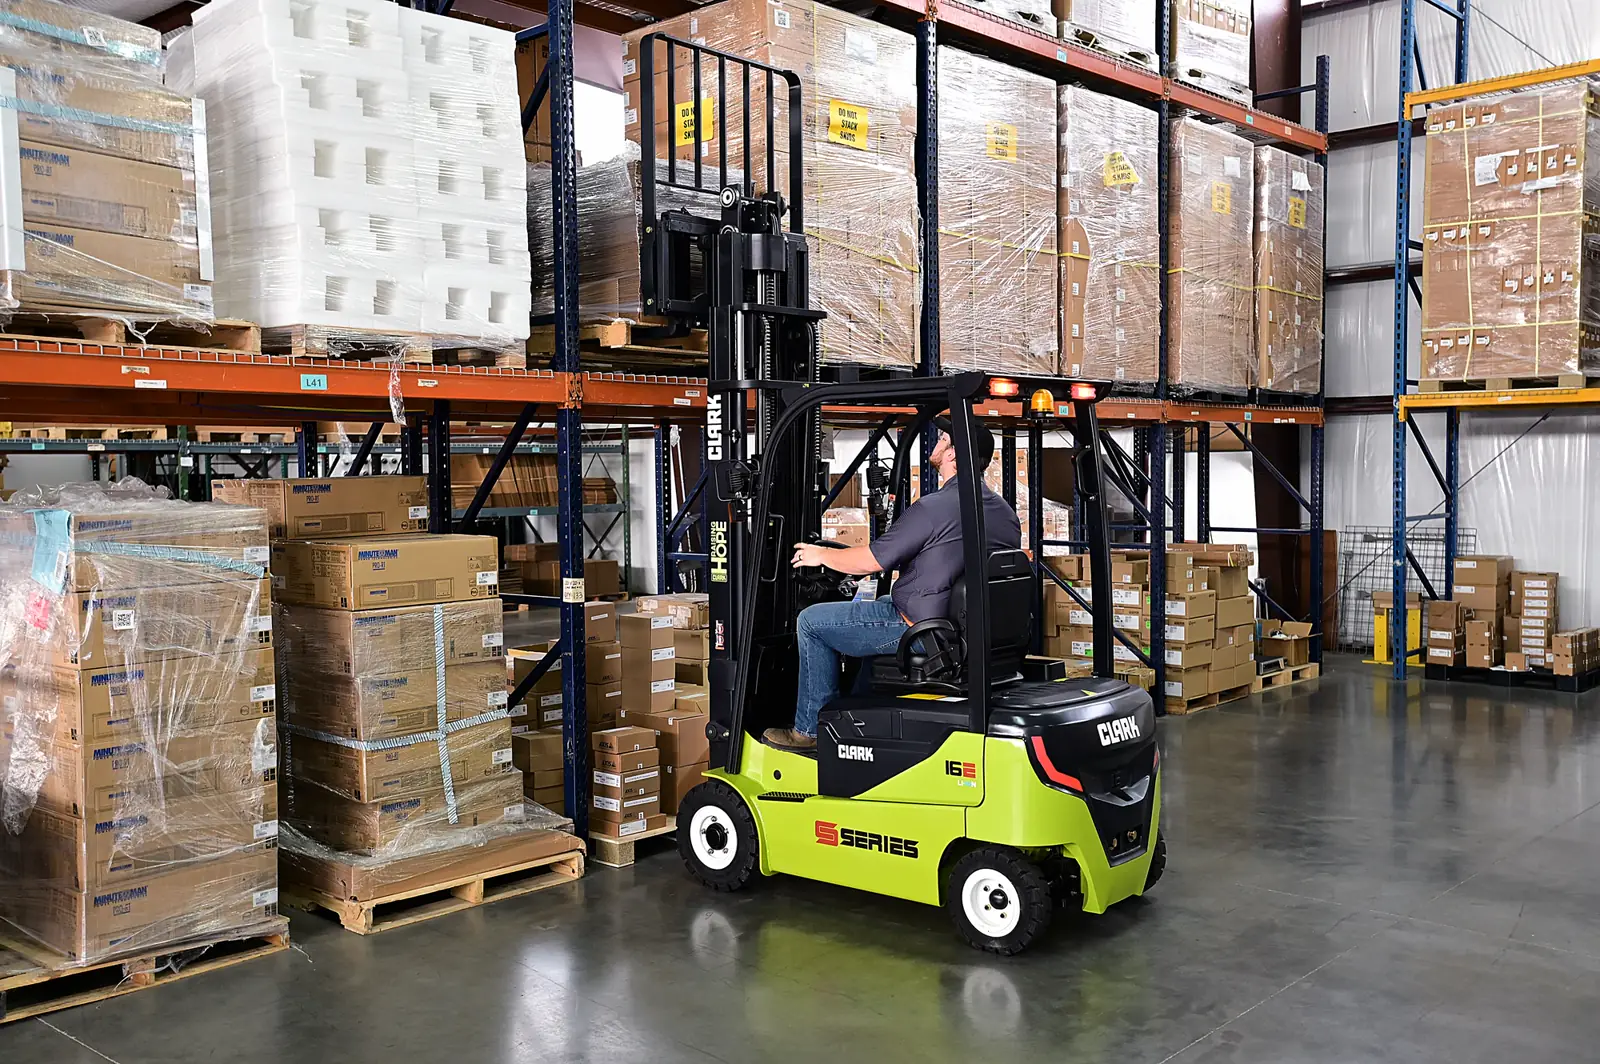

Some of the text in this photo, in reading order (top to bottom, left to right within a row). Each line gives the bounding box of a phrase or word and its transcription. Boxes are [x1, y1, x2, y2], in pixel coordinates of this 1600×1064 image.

[838, 107, 847, 118] DO
[683, 118, 694, 128] STA
[841, 119, 858, 131] STACK
[839, 131, 856, 142] SKIDS
[306, 378, 322, 387] L41
[707, 394, 723, 461] CLARK
[711, 521, 728, 574] HOPE
[1096, 715, 1141, 747] CLARK
[837, 744, 874, 762] CLARK
[945, 759, 977, 779] 16E
[815, 820, 919, 859] S SERIES
